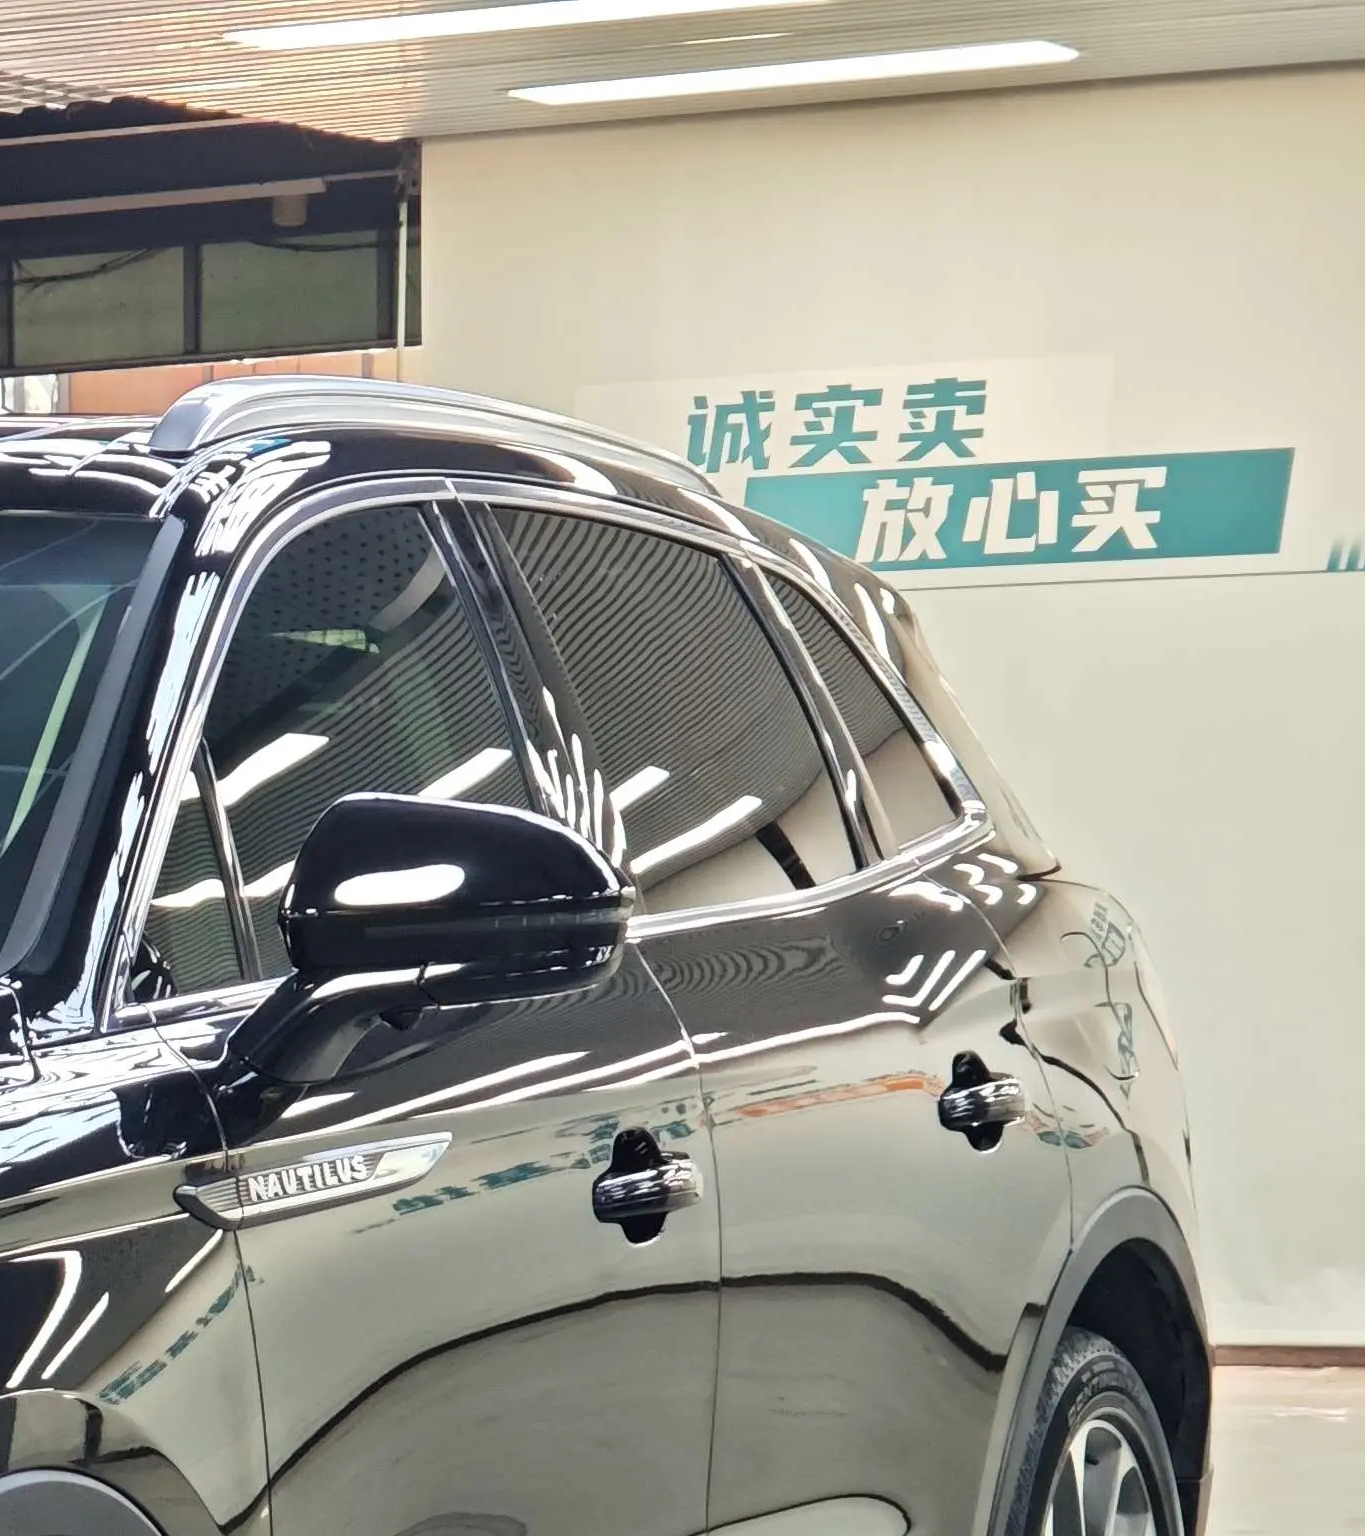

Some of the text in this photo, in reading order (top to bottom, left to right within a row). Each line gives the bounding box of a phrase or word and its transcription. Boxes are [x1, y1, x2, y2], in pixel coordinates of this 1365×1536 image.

[685, 377, 988, 475] 诚实卖
[855, 465, 1168, 563] 放心买
[246, 1153, 368, 1202] NAUTILUS
